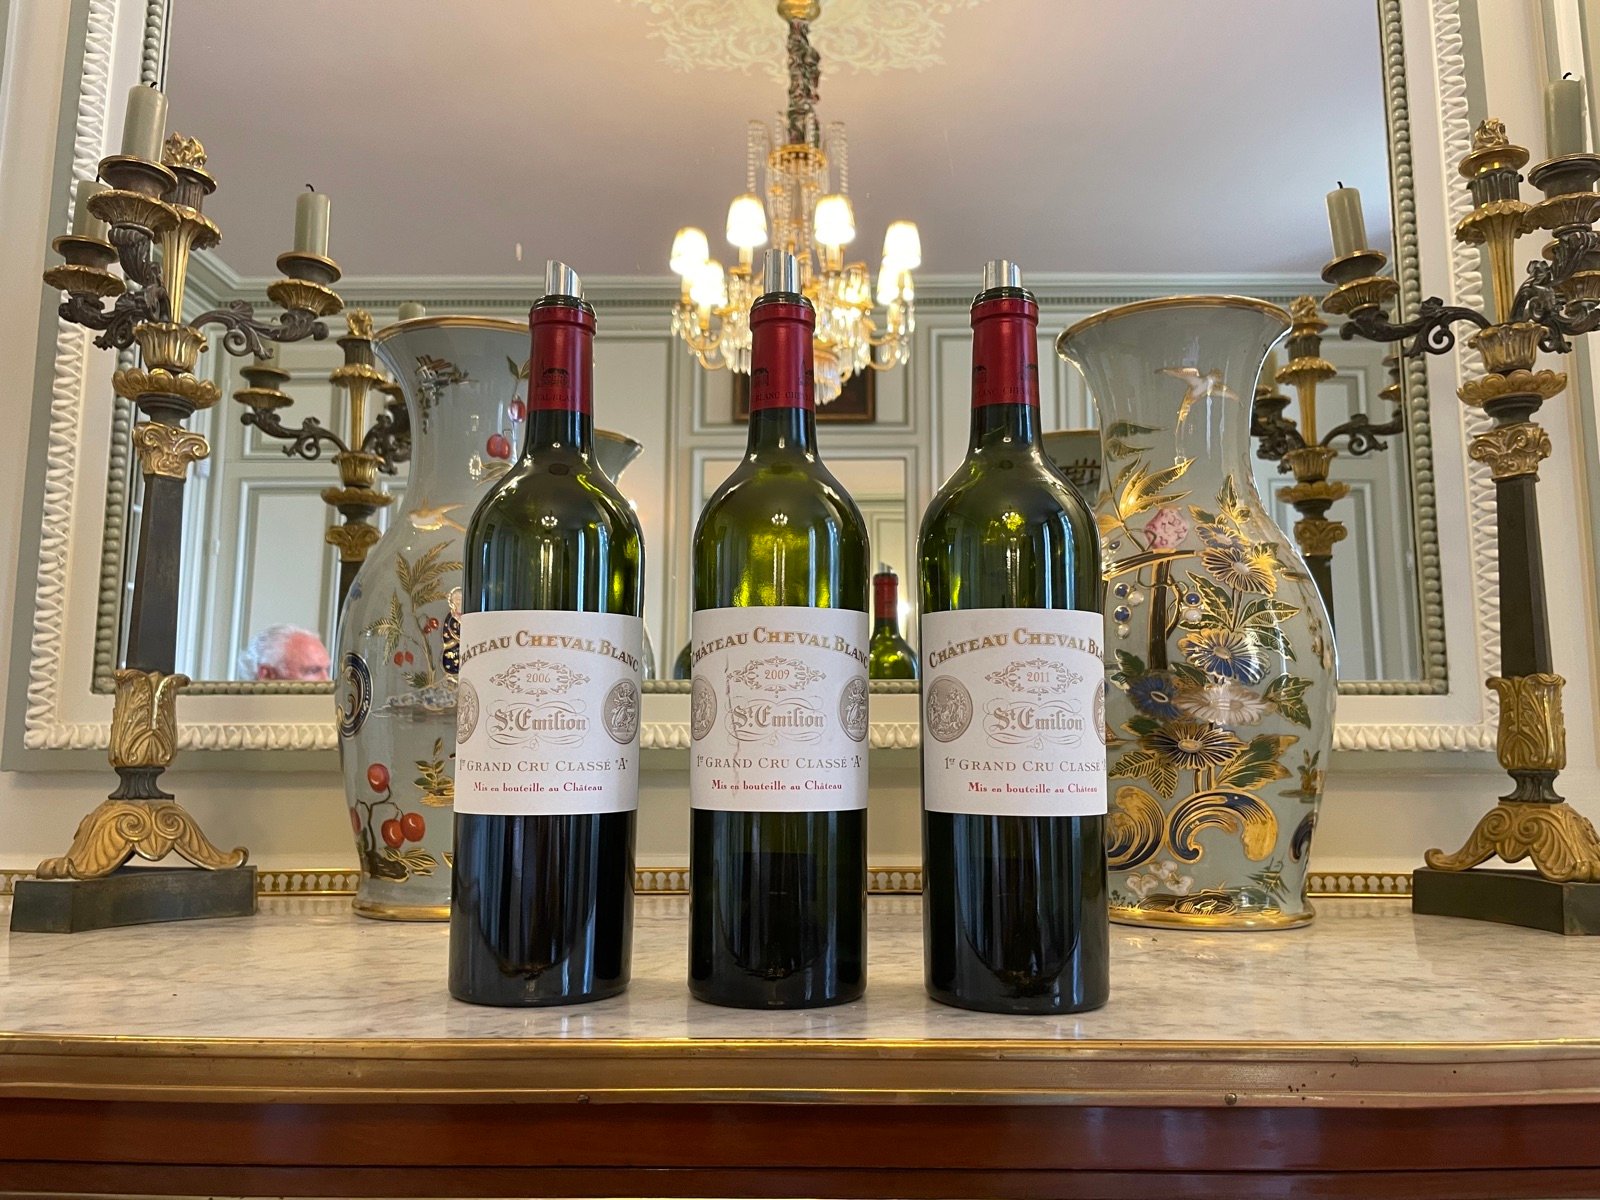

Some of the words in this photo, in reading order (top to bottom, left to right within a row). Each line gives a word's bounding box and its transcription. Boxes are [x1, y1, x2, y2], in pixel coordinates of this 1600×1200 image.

[461, 636, 511, 667] HÂTEAU
[515, 630, 597, 652] CHEVAL
[598, 639, 639, 673] BLANC
[753, 626, 831, 649] CHEVAL
[832, 634, 868, 669] BLANC
[929, 634, 1009, 669] CHÂTEAU
[1013, 627, 1086, 651] CHEVAL
[526, 673, 551, 684] 2006
[764, 669, 790, 680] 2009
[1026, 672, 1050, 683] 2011
[467, 760, 512, 772] GRAND
[517, 760, 549, 772] CRU
[555, 758, 611, 772] CLASSÉ
[705, 757, 753, 768] GRAND
[758, 757, 790, 769] CRU
[796, 755, 847, 769] CLASSÉ
[959, 759, 1016, 772] GRAND
[1022, 760, 1054, 772] CRU
[473, 781, 488, 792] Mis
[503, 782, 545, 792] bouteille
[563, 781, 603, 792] Château
[711, 779, 727, 790] Mis
[743, 780, 786, 790] bouteille
[804, 779, 843, 790] Château
[968, 781, 988, 792] Mis
[1006, 783, 1051, 793] bouteille
[1067, 783, 1098, 793] Château
